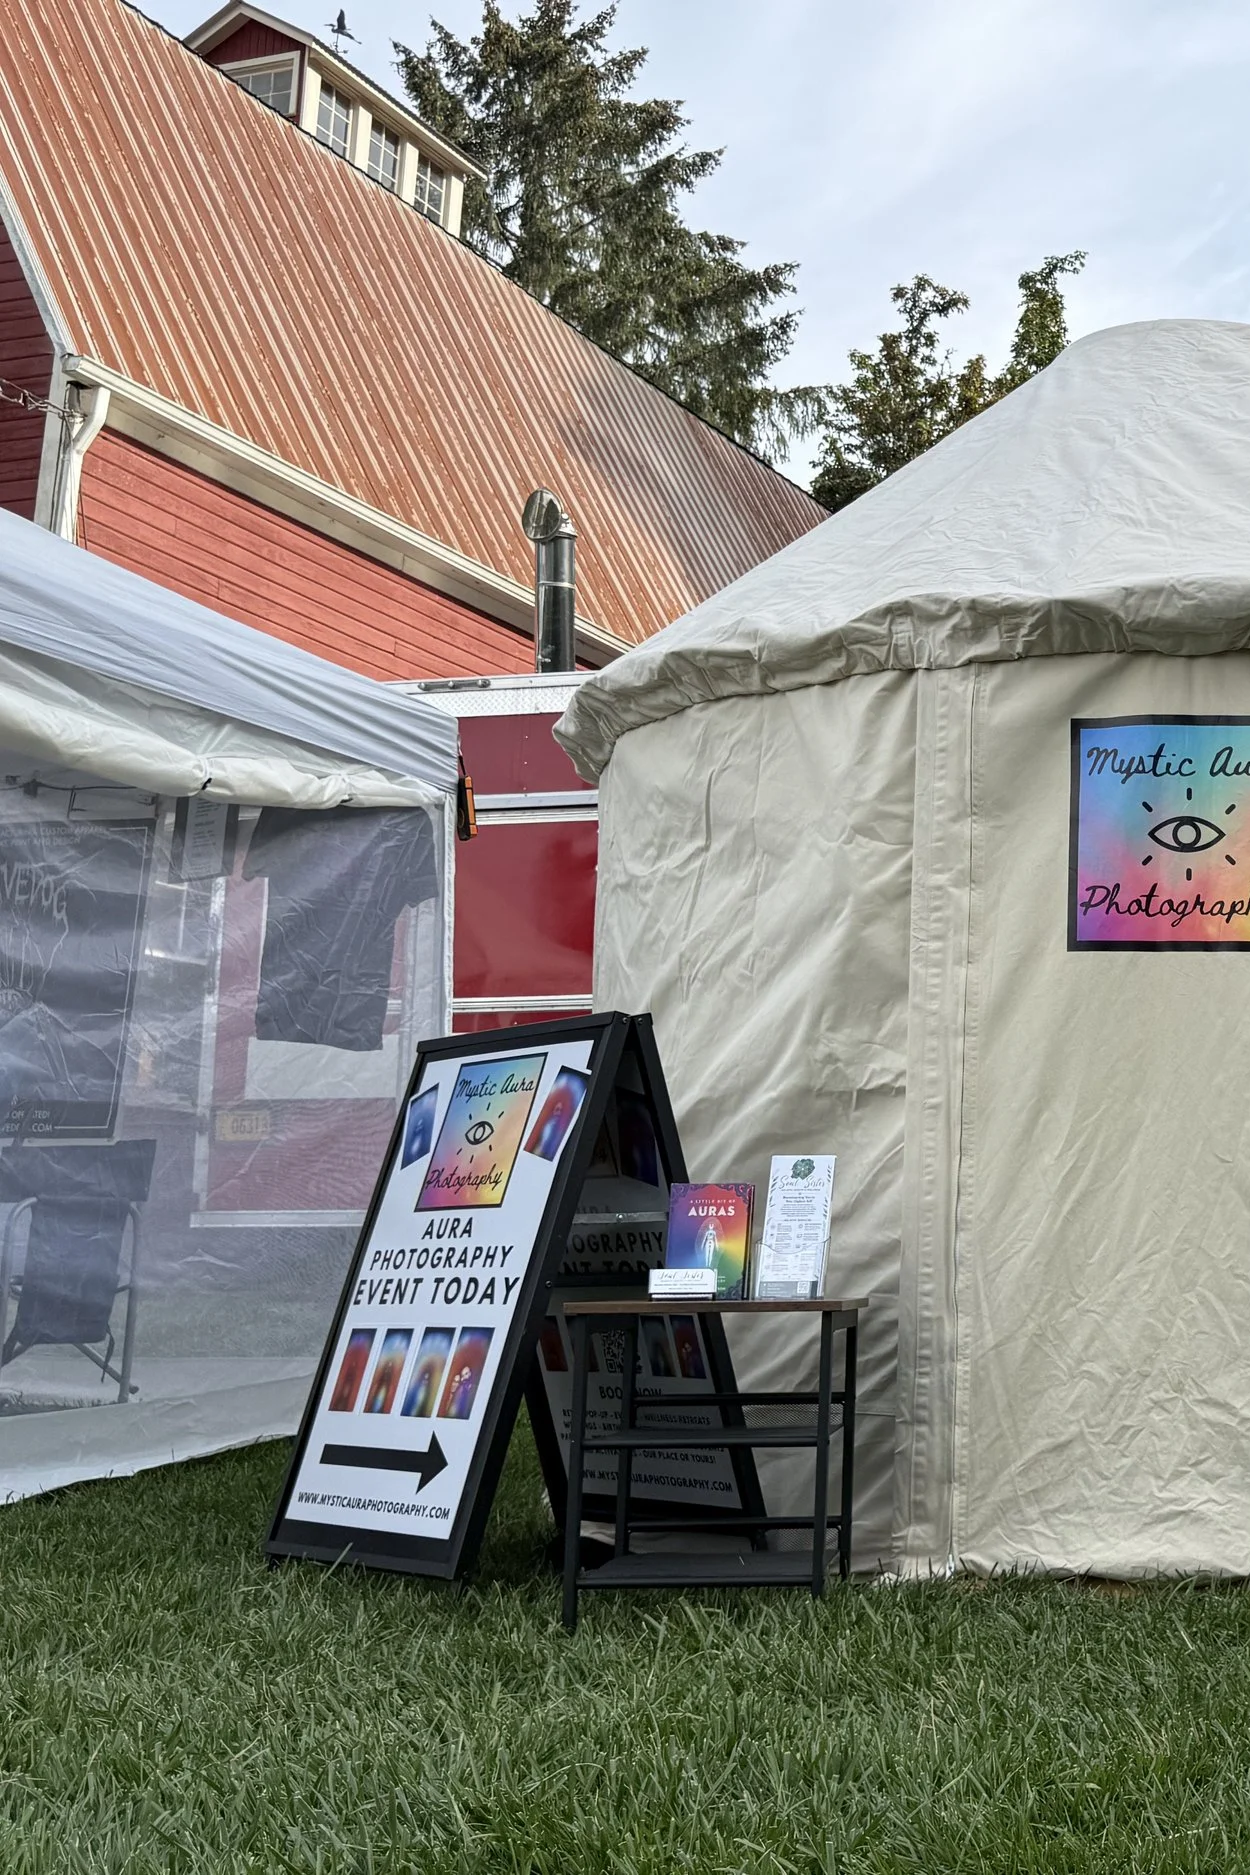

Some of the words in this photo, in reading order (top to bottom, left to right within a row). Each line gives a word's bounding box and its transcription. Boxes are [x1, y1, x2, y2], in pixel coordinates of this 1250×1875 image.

[1087, 743, 1196, 784] Mystic
[456, 1074, 497, 1103] Mystic
[500, 1073, 535, 1095] Aura
[426, 1163, 503, 1194] Photography
[687, 1205, 736, 1217] AURAS
[421, 1216, 473, 1240] AURA
[369, 1246, 514, 1271] PHOTOGRAPHY
[353, 1277, 424, 1306] EVENT
[430, 1276, 520, 1305] TODAY
[298, 1491, 451, 1520] WWW.MYSTICAURAPHOTOGRAPHY.COM
